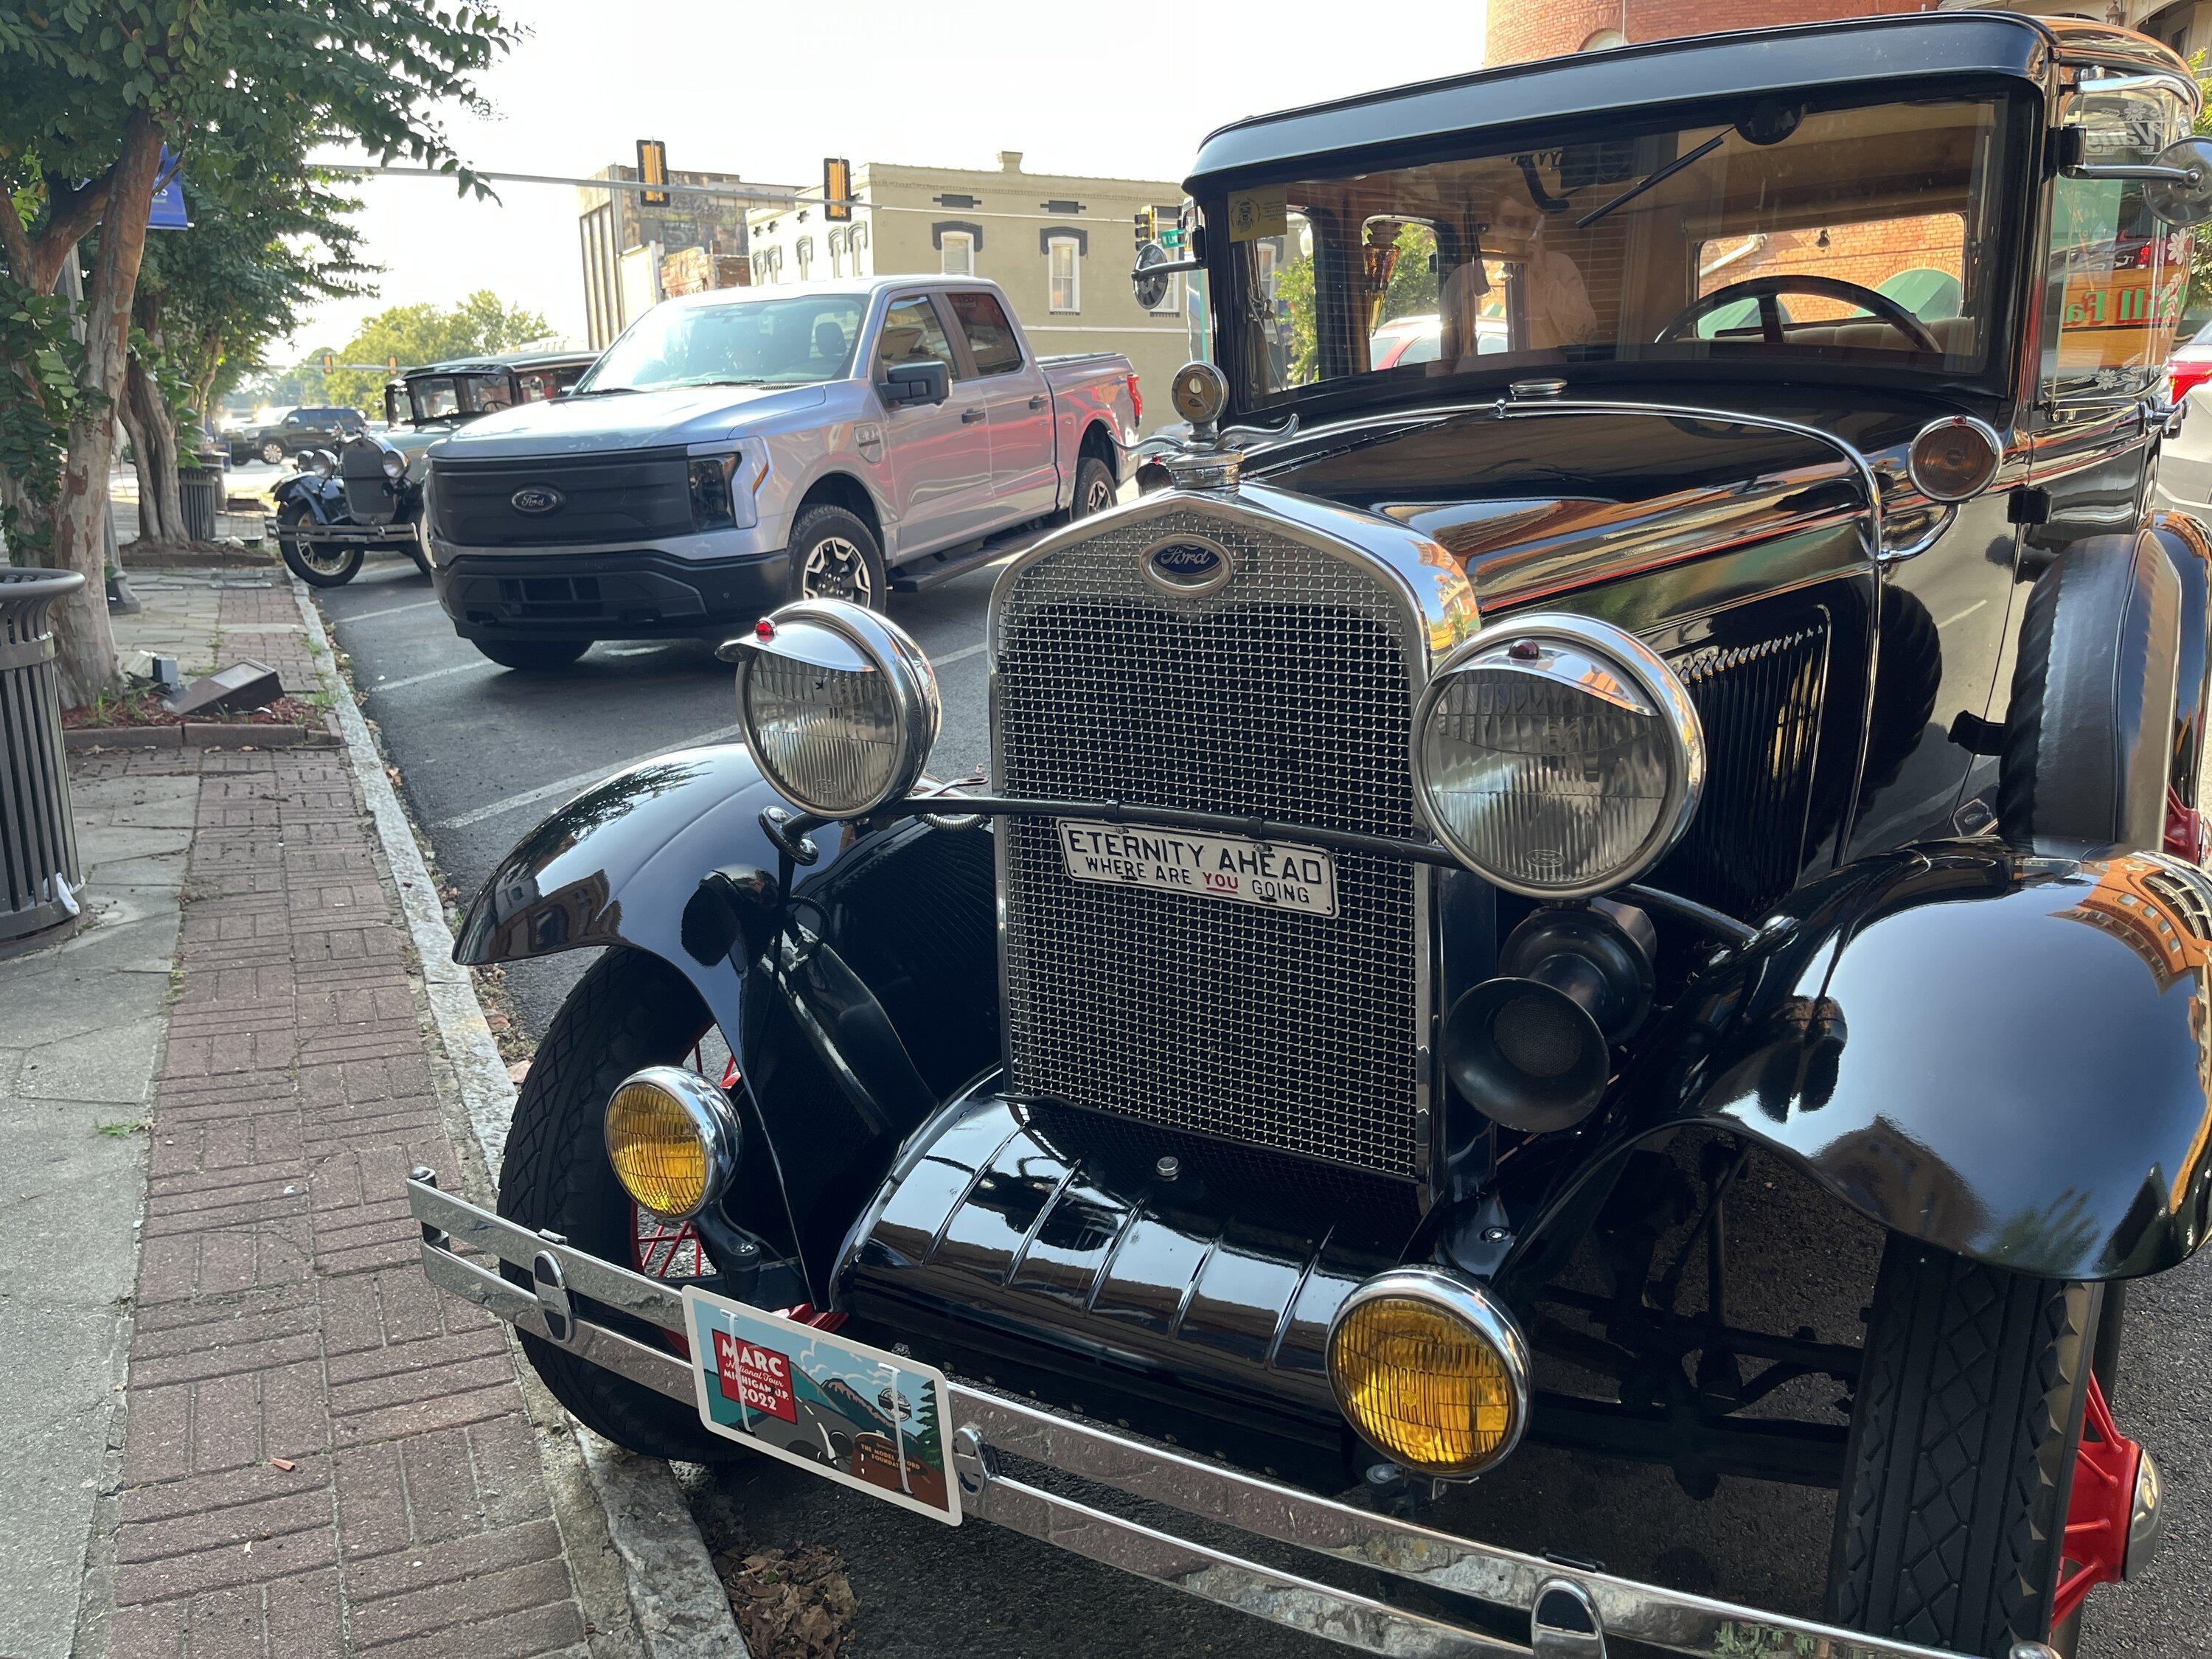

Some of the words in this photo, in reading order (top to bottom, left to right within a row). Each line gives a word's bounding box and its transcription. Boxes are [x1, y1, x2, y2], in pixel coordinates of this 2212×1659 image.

[521, 493, 546, 507] Ford
[1160, 546, 1211, 565] Ford
[1068, 830, 1204, 868] ETERNITY
[1219, 848, 1322, 885] AHEAD
[1085, 856, 1147, 878] WHERE
[1155, 865, 1192, 885] ARE
[1202, 871, 1239, 890] YOU
[1252, 879, 1310, 904] GOING
[722, 1338, 785, 1377] MARC
[726, 1360, 762, 1380] Ntional
[762, 1372, 785, 1388] Tour
[742, 1385, 778, 1411] 2022
[860, 1444, 872, 1453] THE
[874, 1448, 896, 1461] MODEL
[904, 1460, 921, 1470] ORD
[871, 1453, 912, 1473] FOUNDATN
